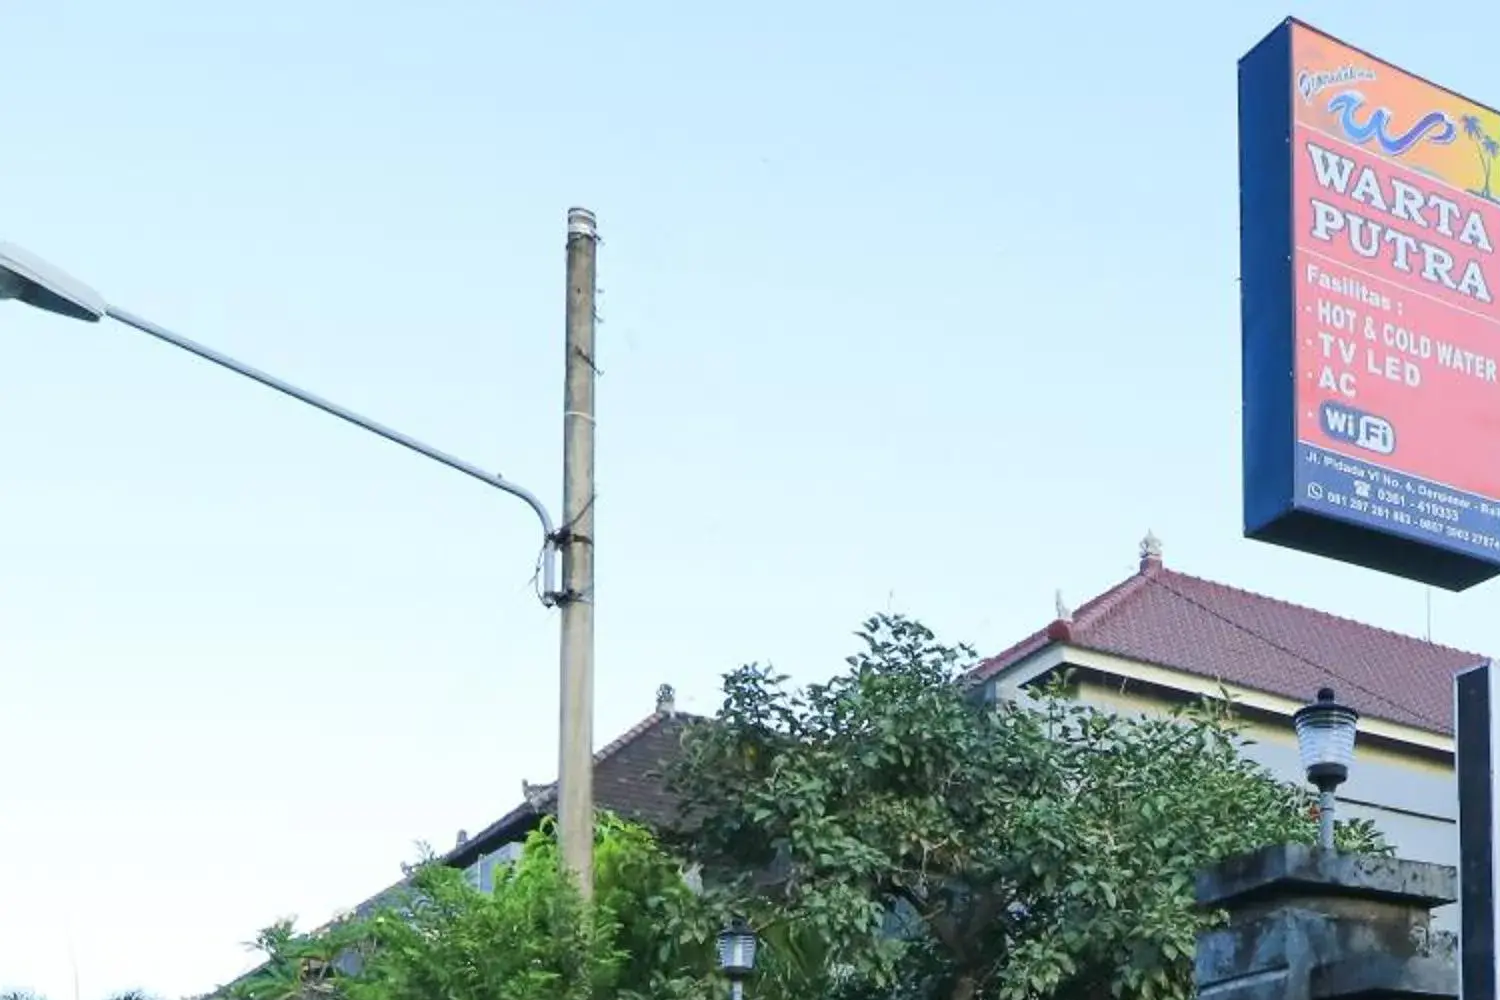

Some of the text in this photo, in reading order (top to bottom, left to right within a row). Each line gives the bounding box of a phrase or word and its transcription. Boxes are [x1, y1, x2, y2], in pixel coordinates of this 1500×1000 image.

[1307, 143, 1493, 253] WARTA
[1311, 200, 1491, 302] PUTRA
[1307, 264, 1390, 310] Fasilitas
[1318, 299, 1497, 382] HOT & COLD WATER
[1319, 333, 1421, 387] TV LED
[1319, 366, 1356, 397] AC
